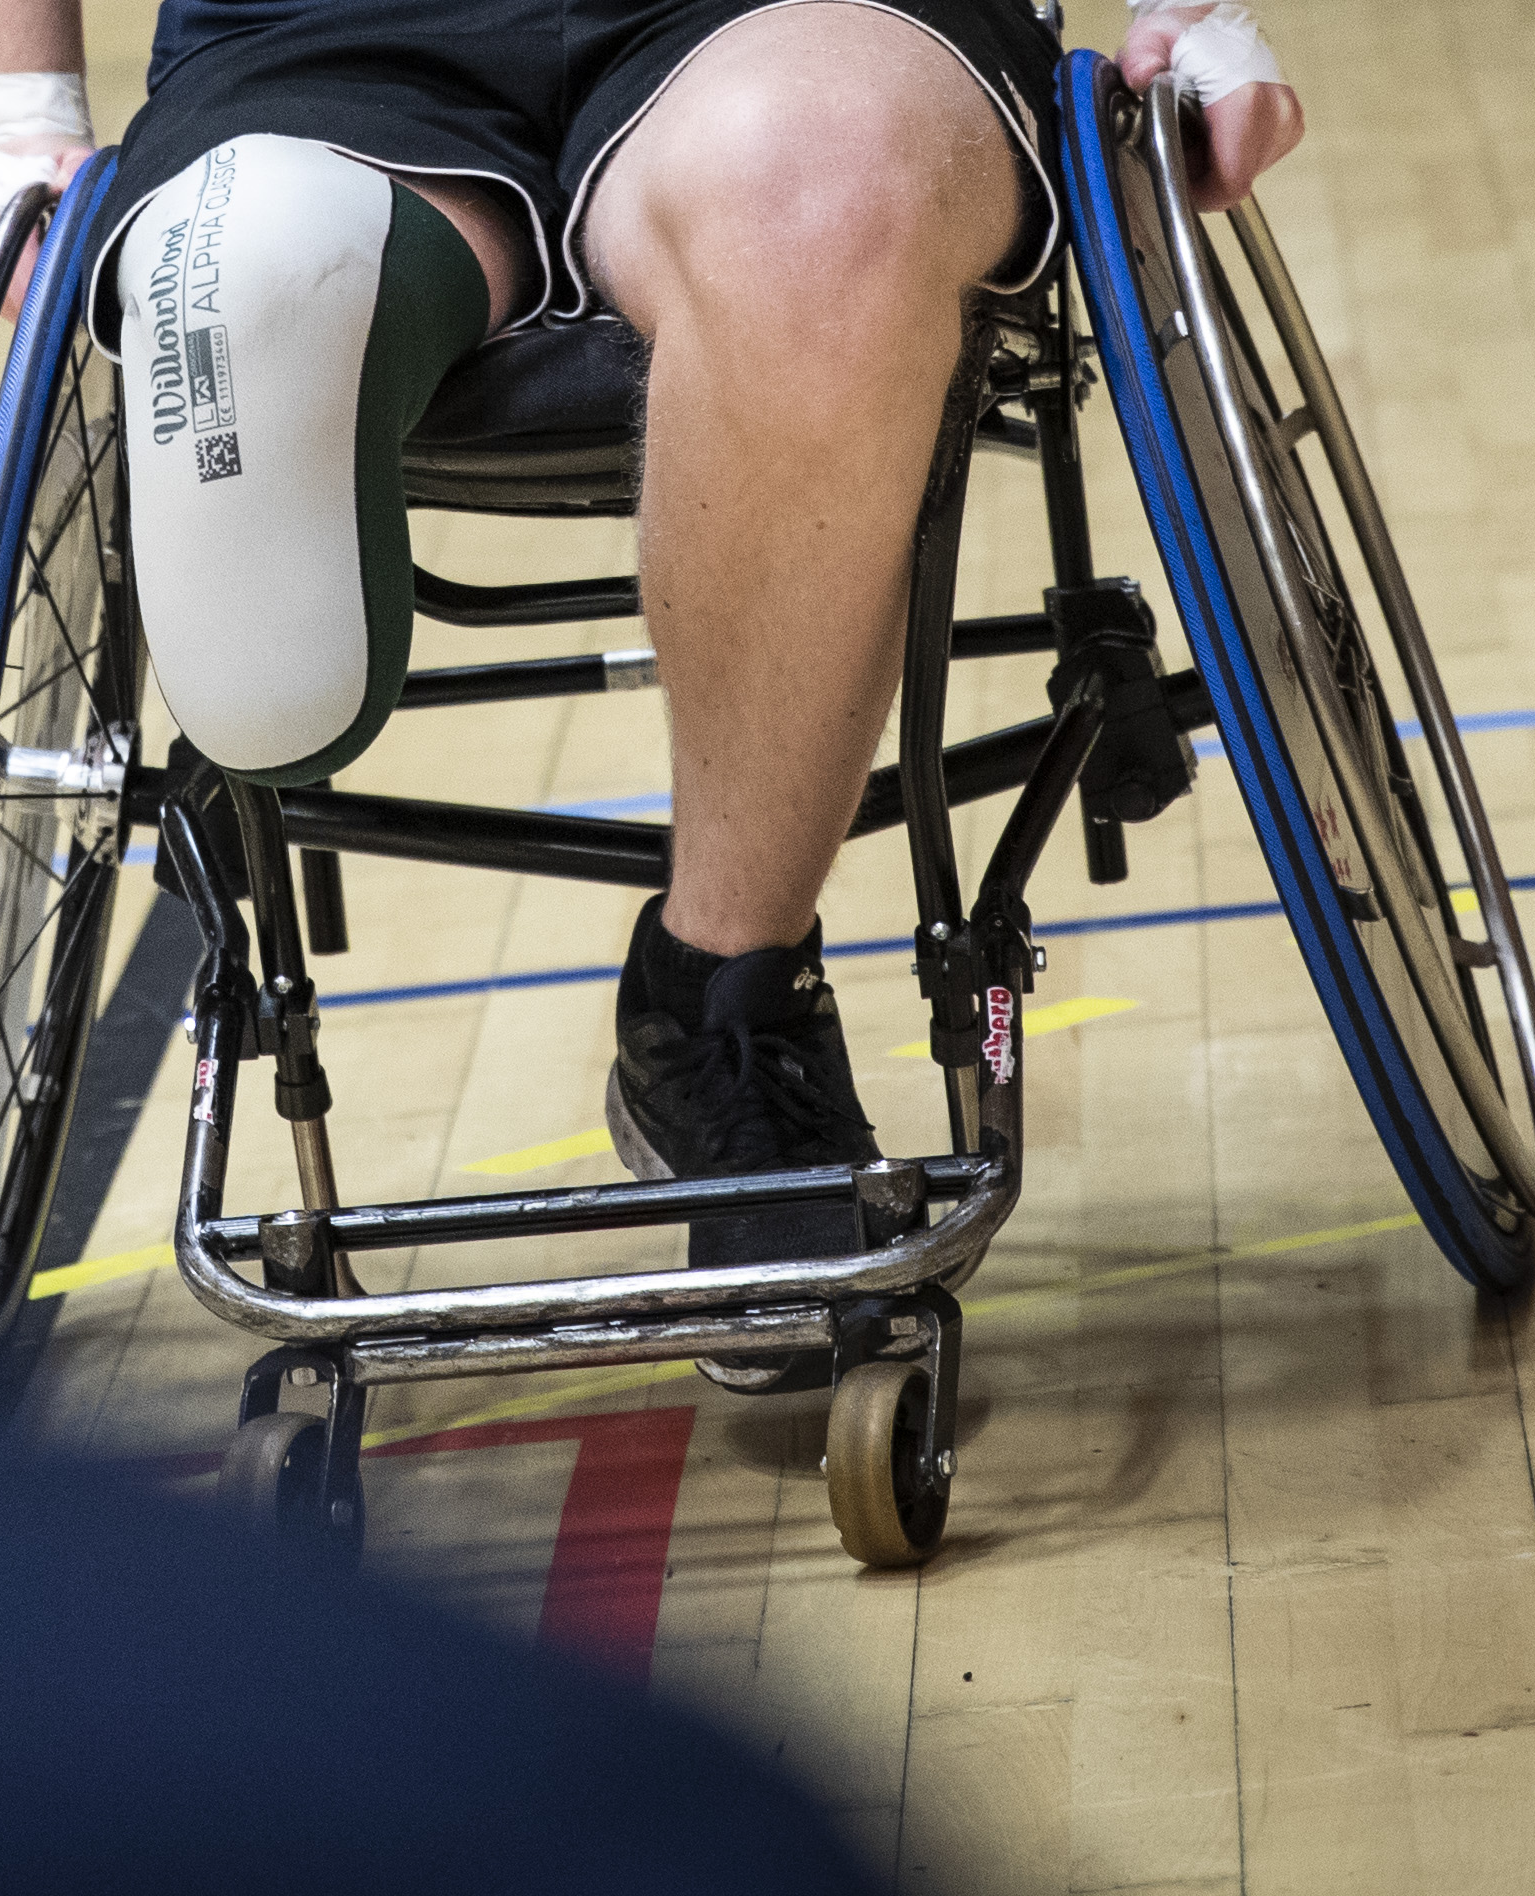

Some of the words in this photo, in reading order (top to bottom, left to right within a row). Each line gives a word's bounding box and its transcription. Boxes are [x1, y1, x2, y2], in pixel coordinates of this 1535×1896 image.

[205, 148, 236, 210] CLASSIC
[192, 214, 225, 313] ALPHA
[148, 218, 190, 445] WillowWood
